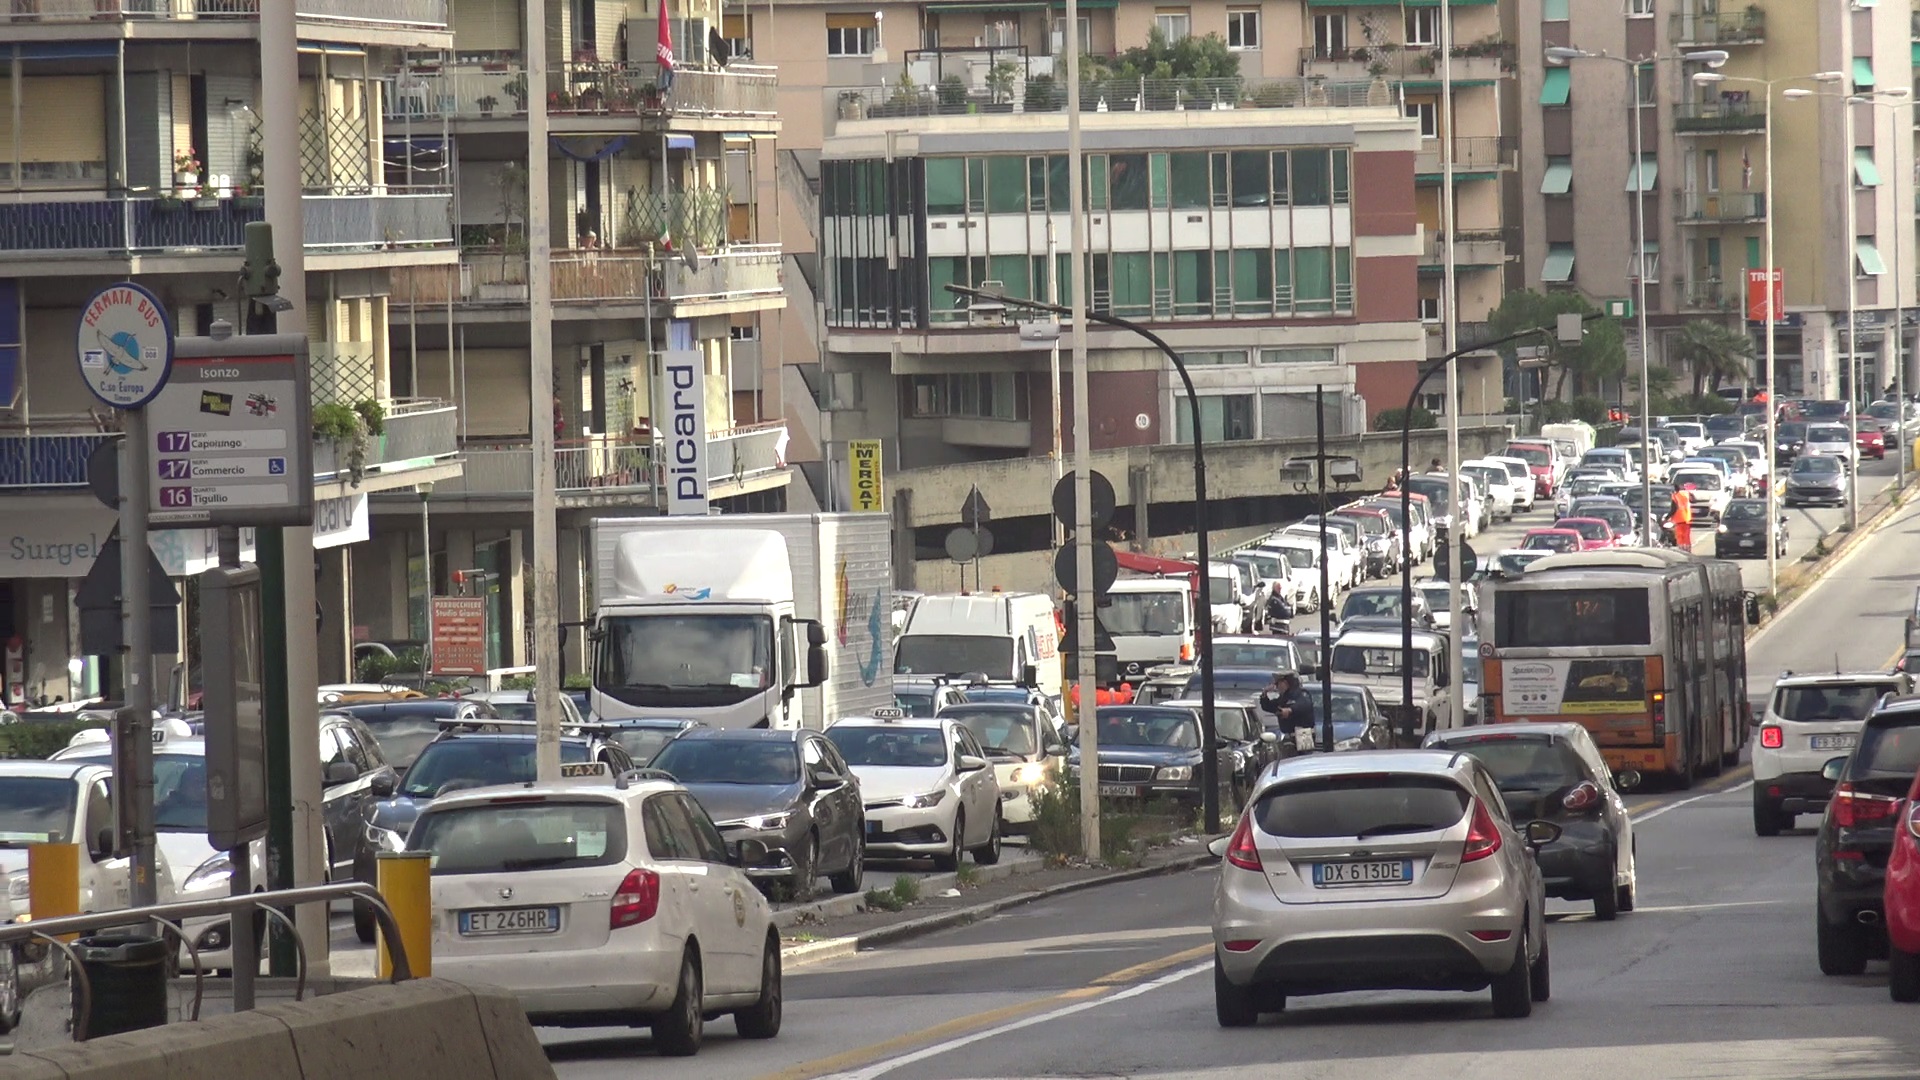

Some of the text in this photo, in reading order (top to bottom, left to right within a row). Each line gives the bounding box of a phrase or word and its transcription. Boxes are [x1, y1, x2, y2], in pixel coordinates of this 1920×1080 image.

[85, 290, 159, 327] FERMATA BUS
[200, 367, 240, 378] Isonzo
[119, 381, 144, 395] Europa
[666, 365, 704, 500] picard
[166, 433, 188, 450] 17
[167, 460, 245, 477] 17 Commercio
[167, 489, 228, 505] 16 Tigullio
[10, 533, 104, 567] Surgel
[436, 609, 457, 617] Studio
[877, 709, 899, 717] TAXI
[563, 764, 603, 776] TAXI
[1324, 863, 1401, 881] DX 613DE
[471, 911, 547, 930] ET 246HR
